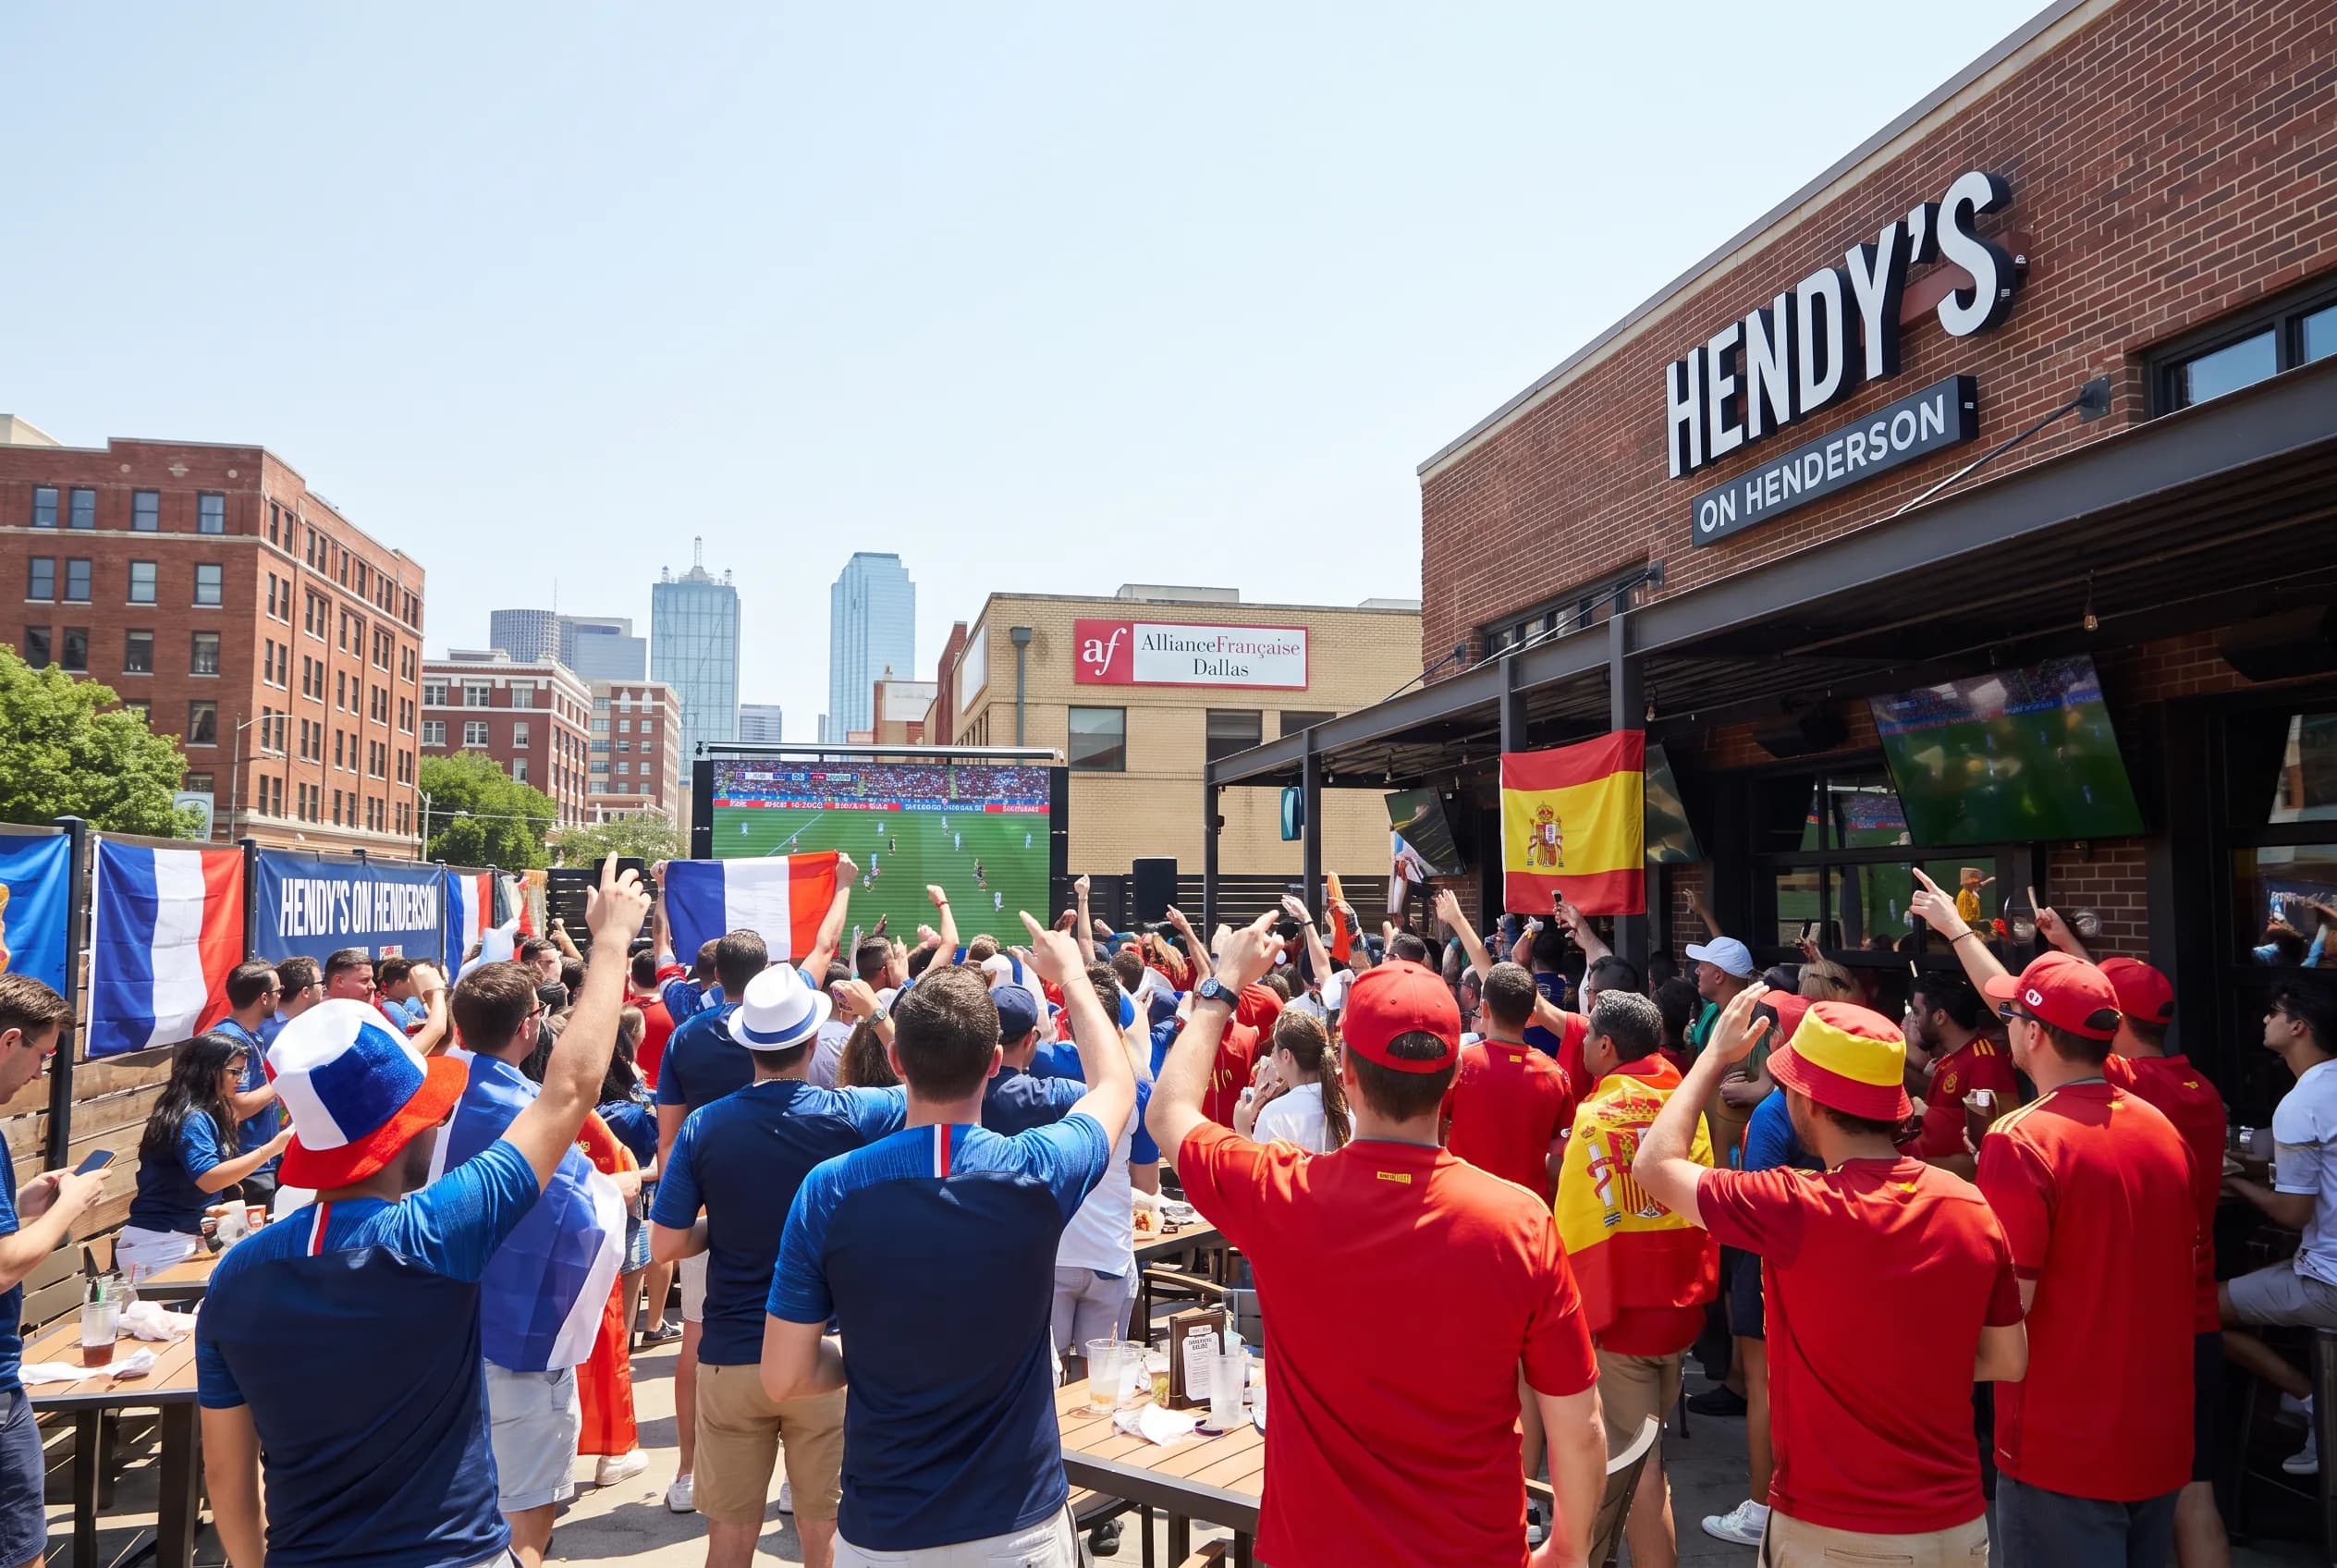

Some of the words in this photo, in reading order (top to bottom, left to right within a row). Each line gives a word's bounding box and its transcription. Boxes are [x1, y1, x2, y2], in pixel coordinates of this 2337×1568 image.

[1666, 170, 1998, 480] HENDY'S
[1699, 488, 1737, 533] ON
[1745, 393, 1945, 516] HENDERSON
[1082, 627, 1128, 676] af
[1141, 633, 1301, 659] AllianceFrançaise
[1193, 657, 1249, 677] Dallas
[279, 877, 350, 937] HENDY'S
[352, 880, 373, 934] ON
[373, 881, 437, 933] HENDERSON
